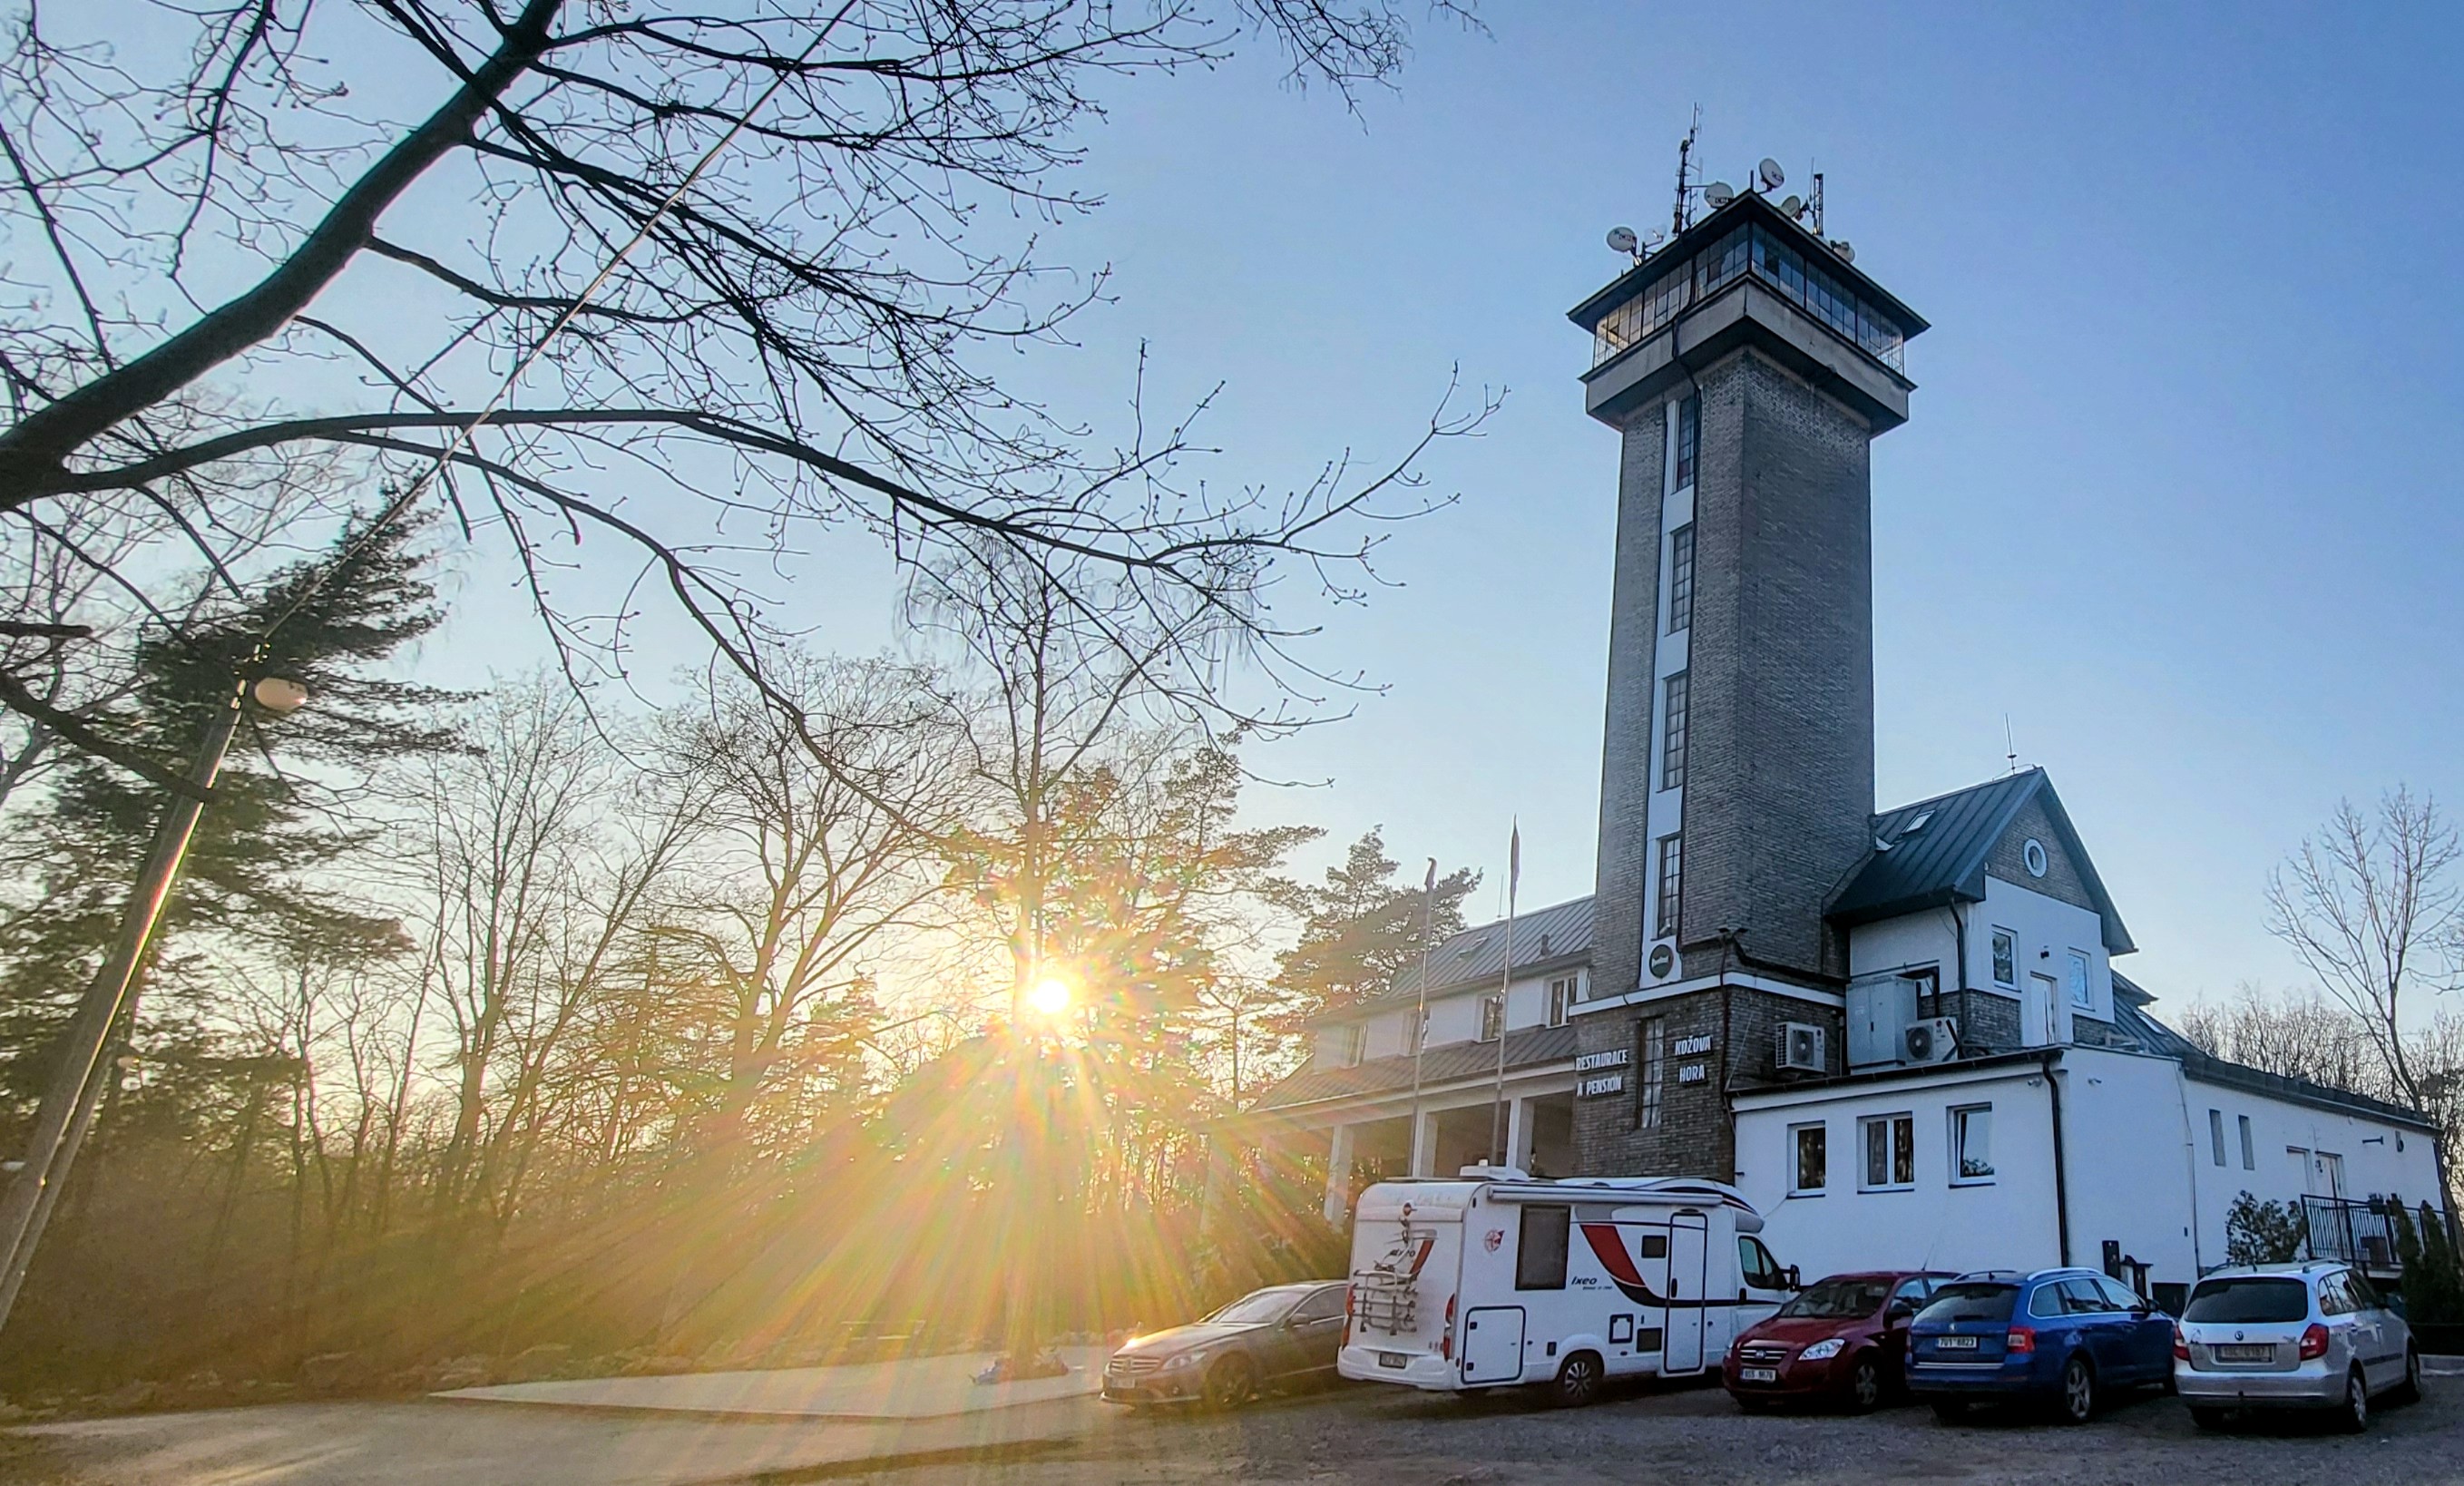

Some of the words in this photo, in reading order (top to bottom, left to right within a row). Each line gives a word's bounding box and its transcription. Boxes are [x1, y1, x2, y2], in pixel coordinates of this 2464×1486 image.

[1675, 1034, 1712, 1056] KOŽOVA
[1576, 1049, 1628, 1071] RESTAURACE
[1679, 1064, 1705, 1083] HORA
[1577, 1081, 1583, 1097] A
[1586, 1075, 1622, 1096] PENSION
[1570, 1276, 1598, 1286] Ixeo
